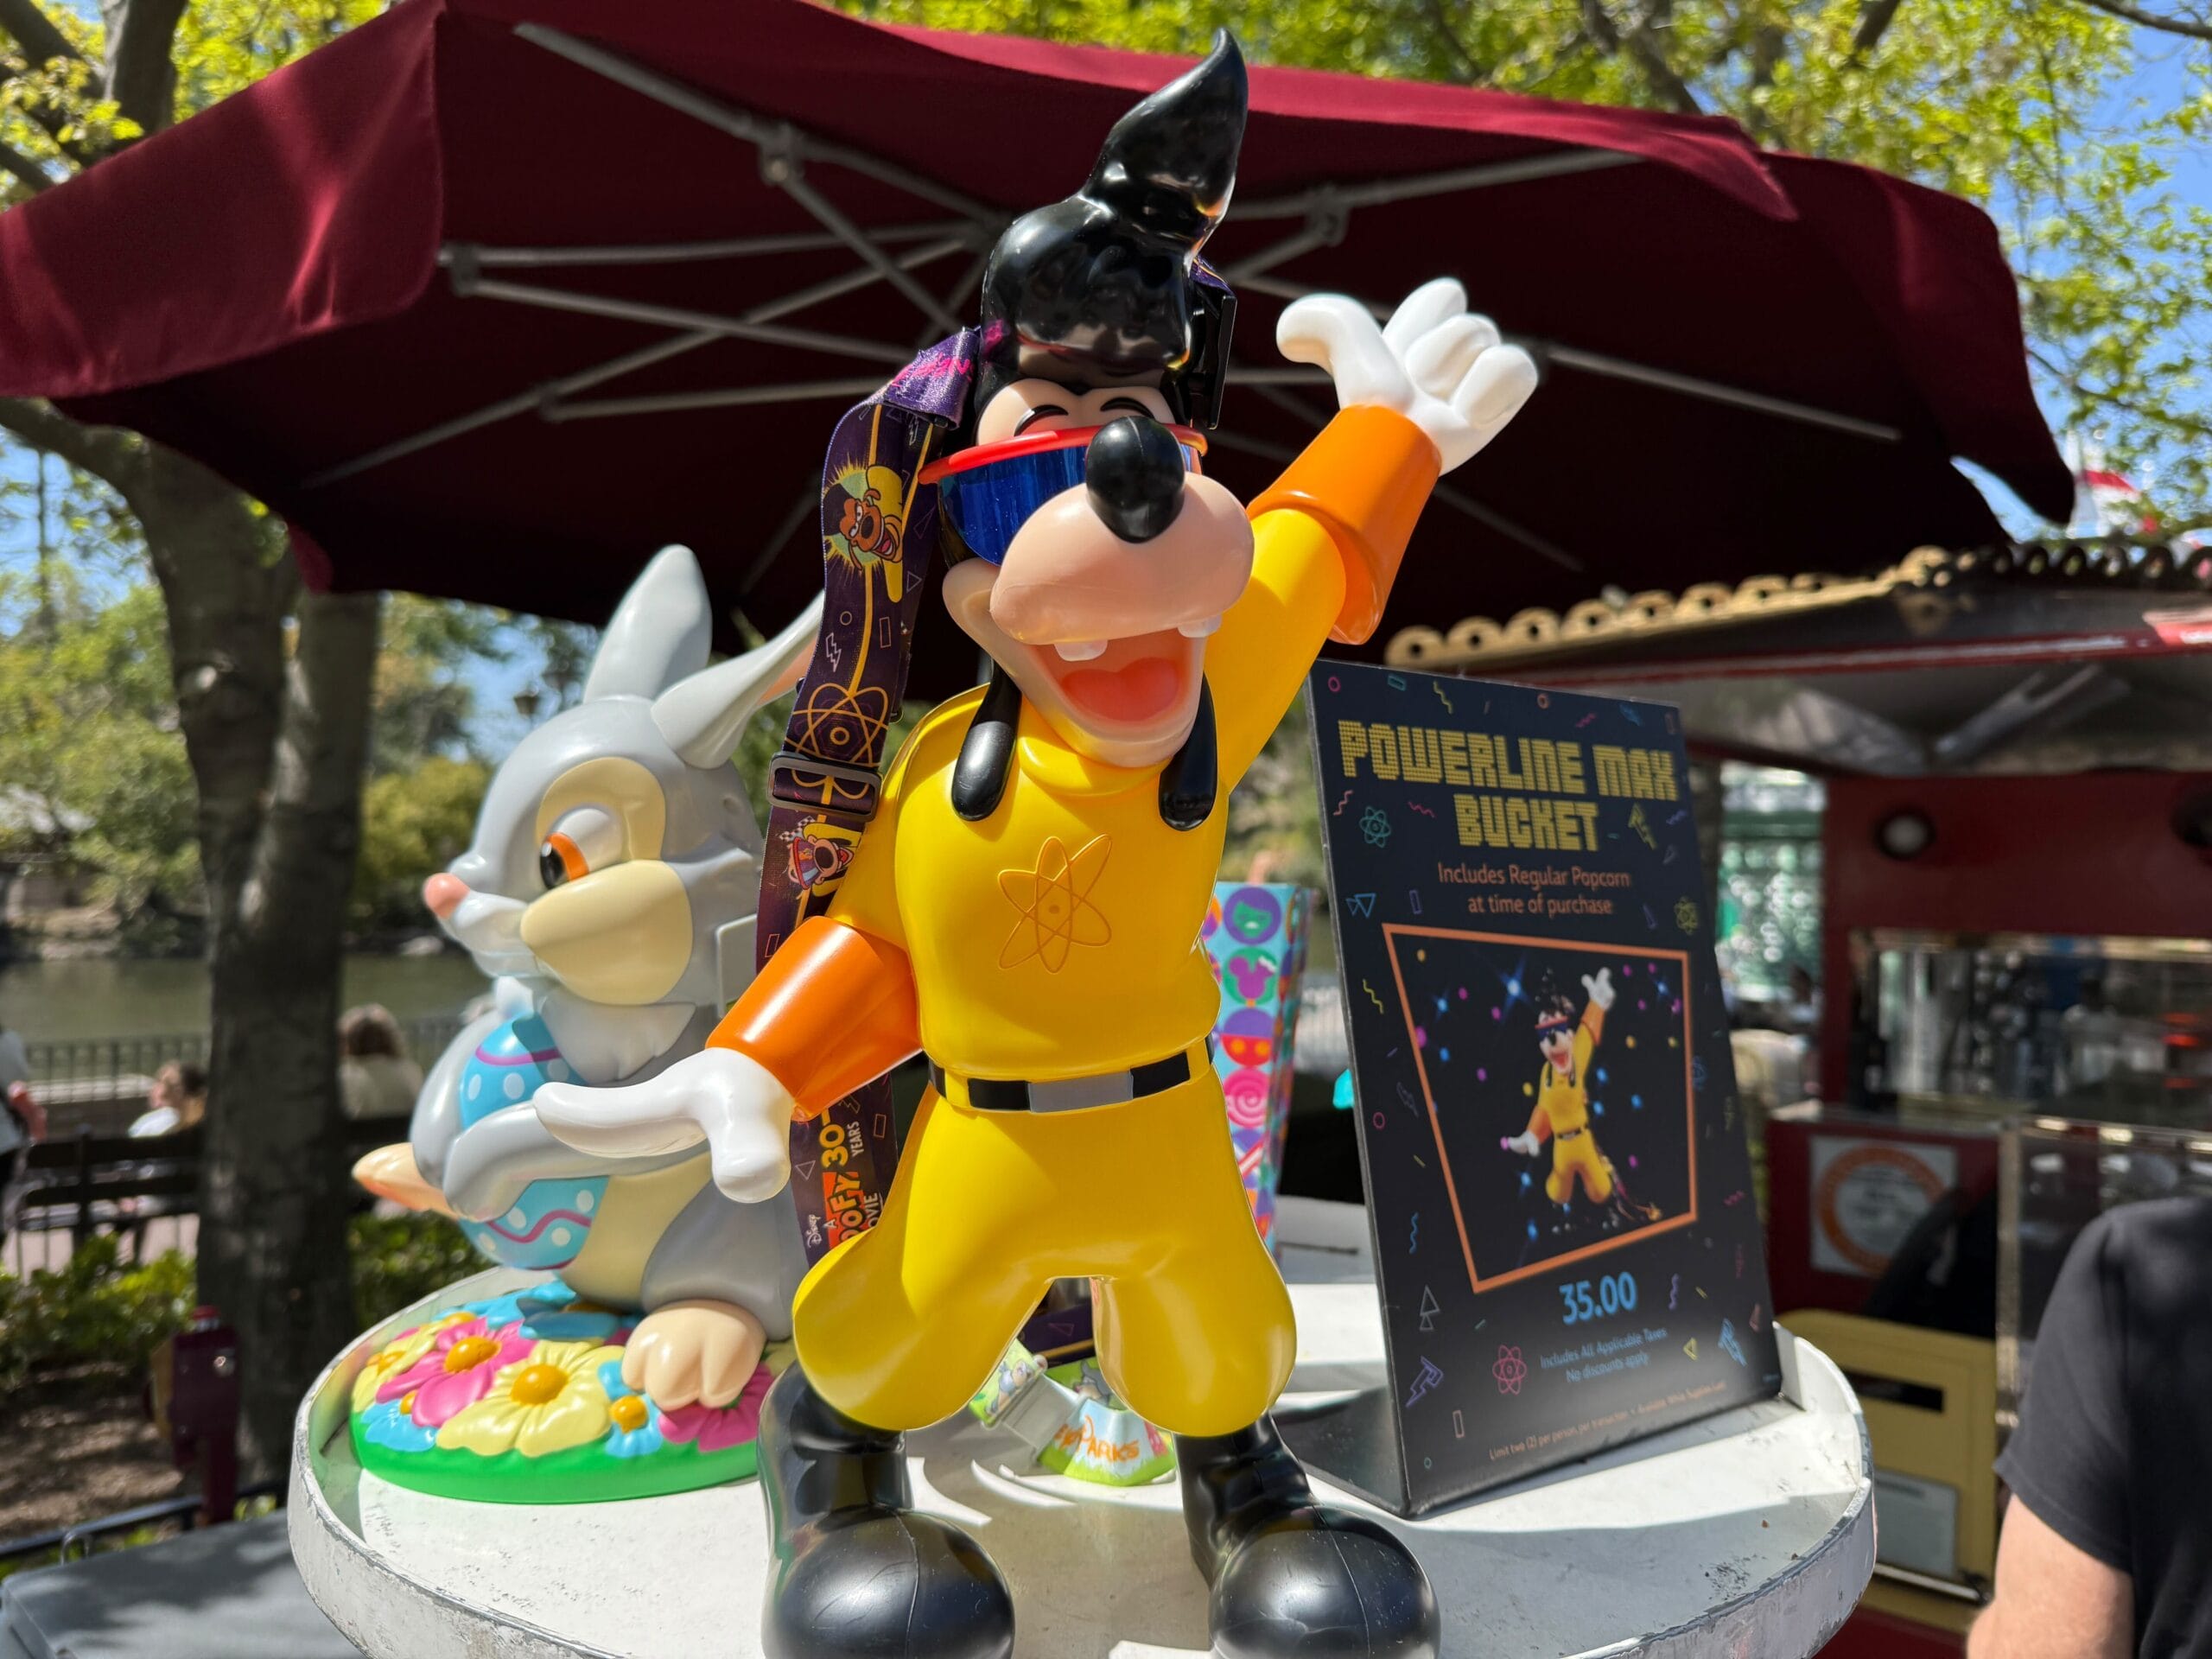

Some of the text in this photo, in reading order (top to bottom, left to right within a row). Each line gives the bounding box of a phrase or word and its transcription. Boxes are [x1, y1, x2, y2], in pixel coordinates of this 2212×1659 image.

[1338, 720, 1679, 801] POWERLINE MAX
[1453, 793, 1599, 851] BUCKET
[1438, 862, 1630, 891] Includes Regular Popcorn
[1468, 893, 1612, 918] at time of purchase
[819, 1124, 849, 1167] 30
[847, 1122, 864, 1157] YEARS
[823, 1218, 837, 1229] A
[863, 1192, 878, 1227] OVIE
[1559, 1271, 1637, 1325] 35.00
[1540, 1349, 1579, 1369] Includes
[1596, 1333, 1643, 1356] Applicable
